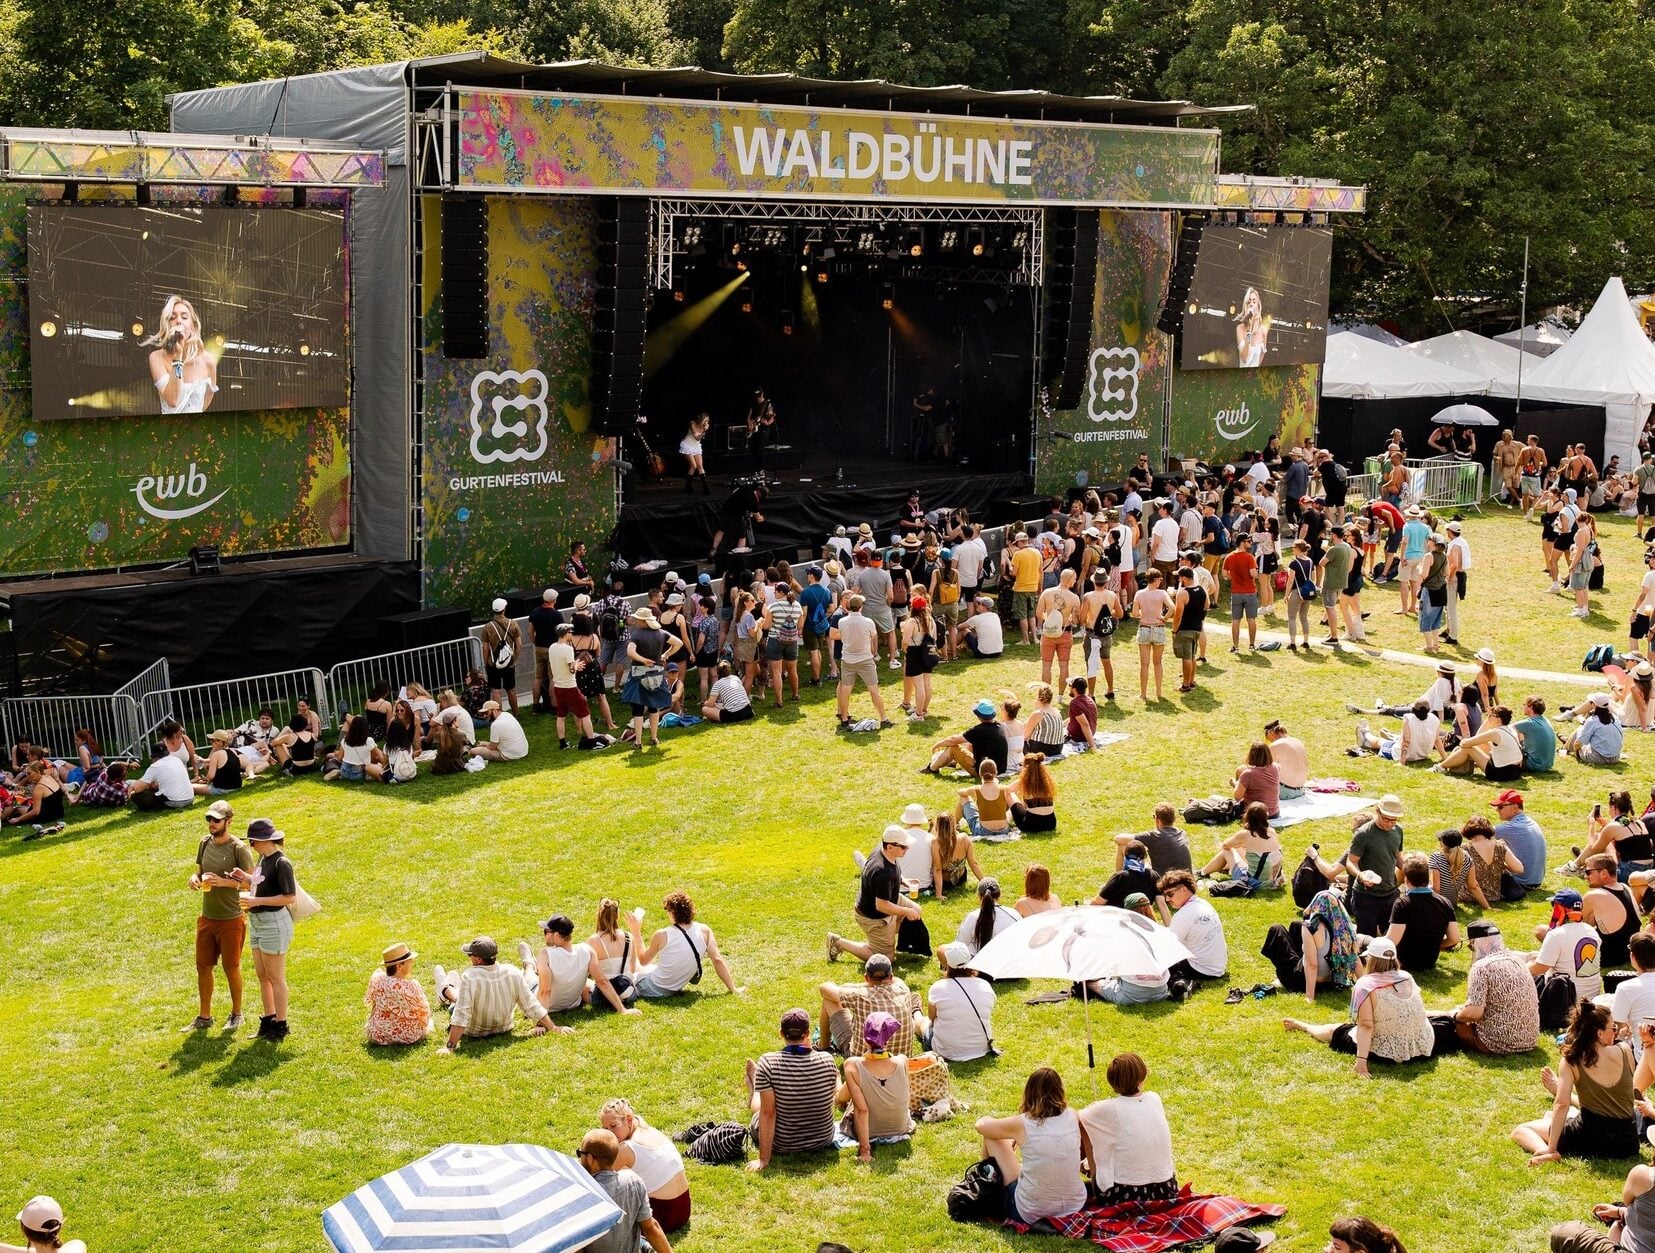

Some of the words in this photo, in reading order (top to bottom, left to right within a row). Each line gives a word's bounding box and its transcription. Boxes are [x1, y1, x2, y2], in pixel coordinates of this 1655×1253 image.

[733, 123, 1031, 185] WALDBÜHNE
[1074, 429, 1148, 442] GURTENFESTIVAL
[1213, 401, 1261, 440] ewb
[129, 462, 232, 519] ewb
[450, 471, 565, 490] GURTENFESTIVAL
